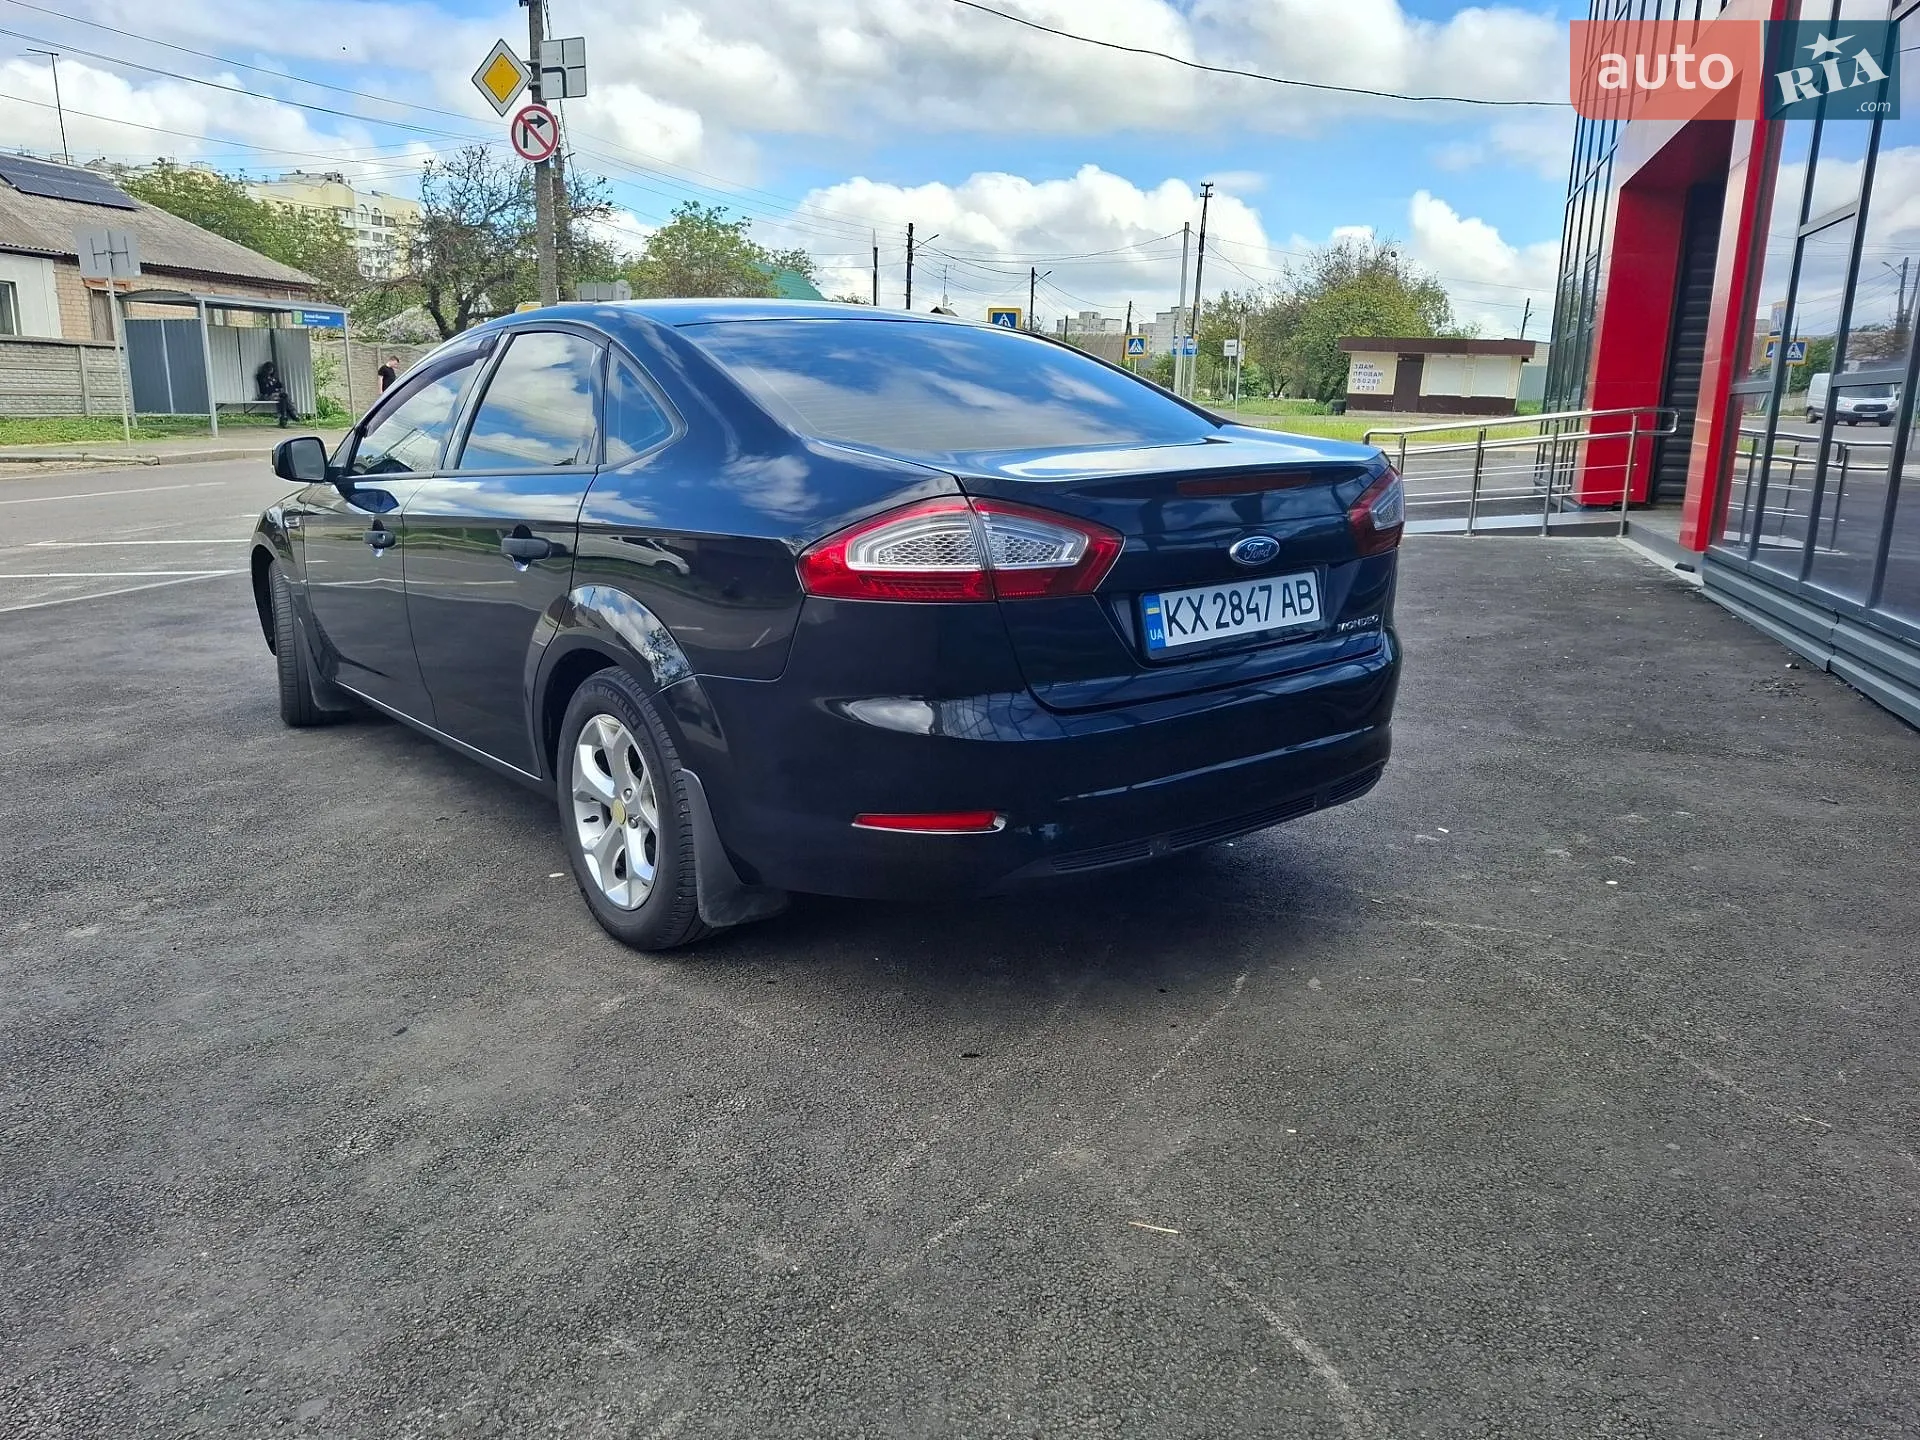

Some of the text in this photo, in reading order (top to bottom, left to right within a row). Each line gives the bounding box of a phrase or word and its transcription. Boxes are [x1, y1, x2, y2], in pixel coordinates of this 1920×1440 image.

[1244, 543, 1272, 560] Ford
[1164, 579, 1315, 637] KX 2847 AB
[1150, 628, 1164, 640] UA
